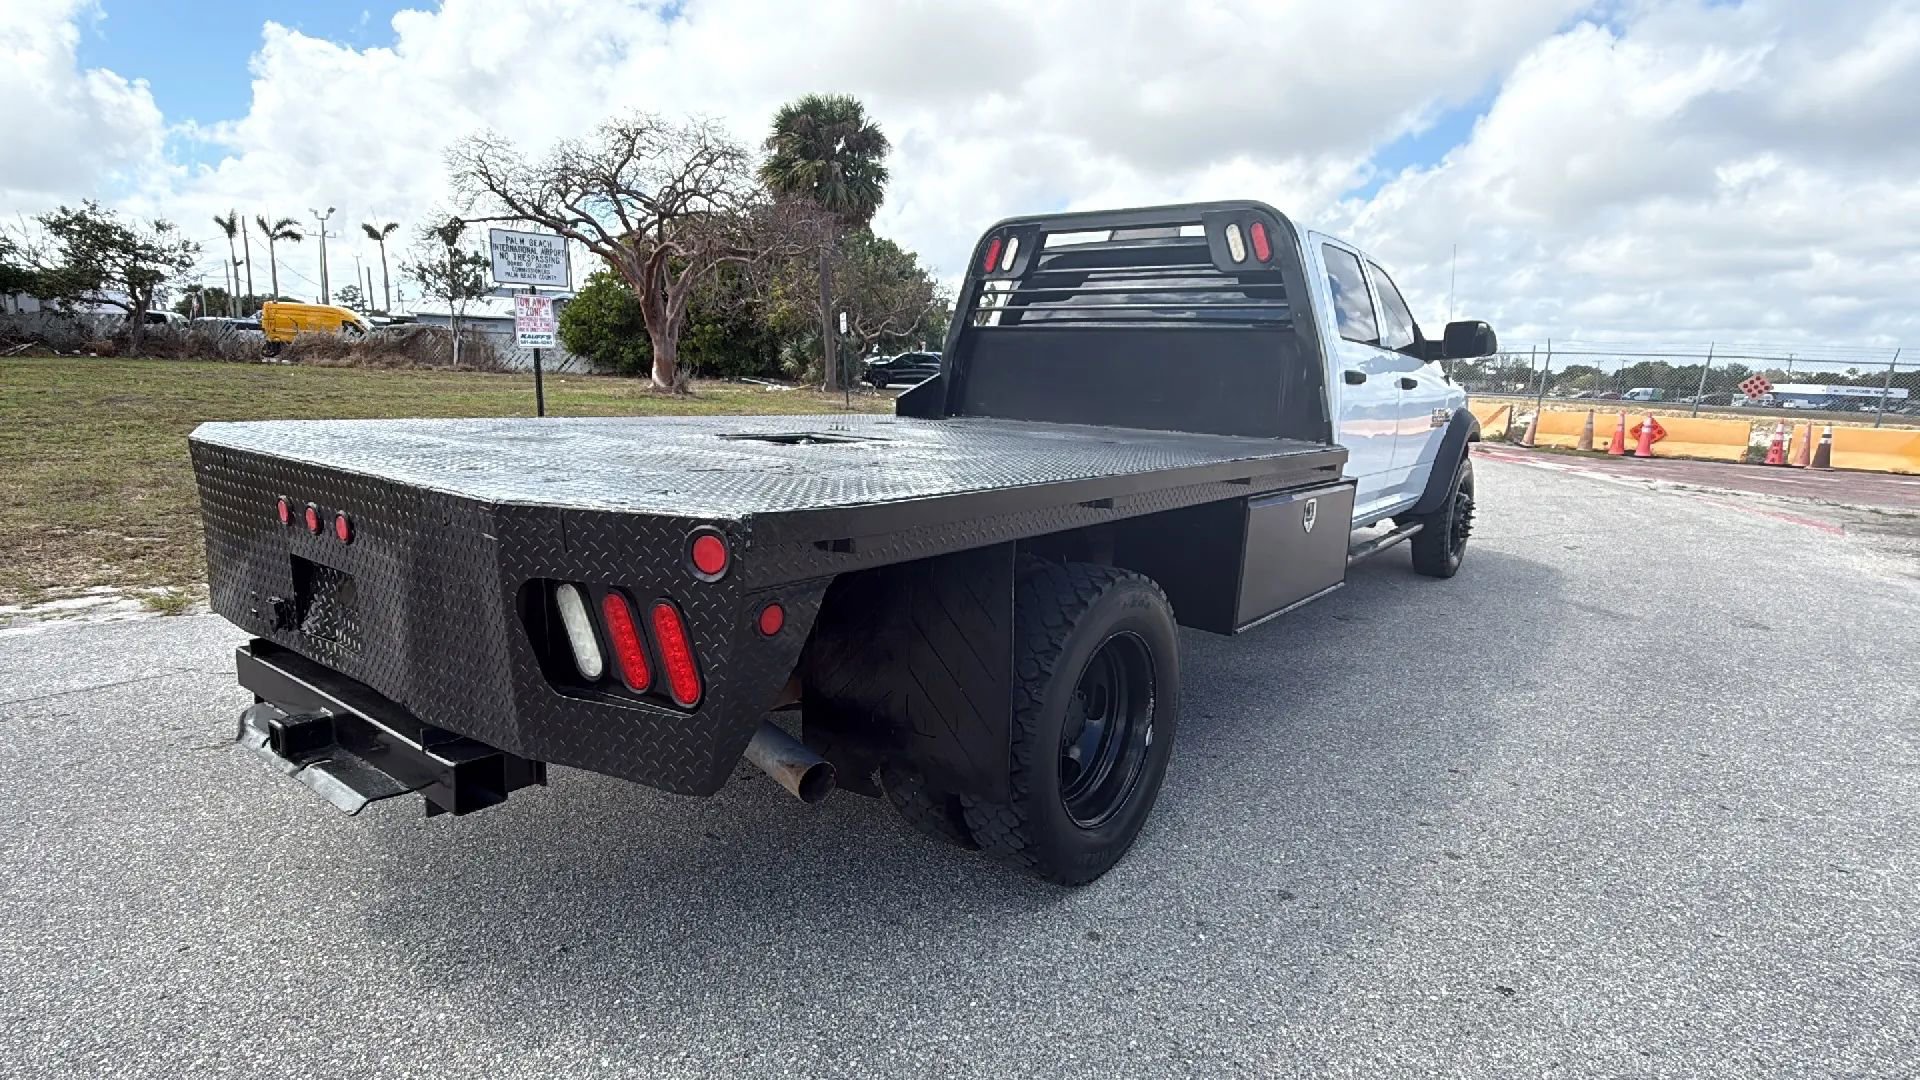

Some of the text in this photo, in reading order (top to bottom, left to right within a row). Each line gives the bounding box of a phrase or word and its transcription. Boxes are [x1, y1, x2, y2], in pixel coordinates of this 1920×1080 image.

[505, 236, 552, 248] PALM BEACH
[493, 244, 565, 257] INTERNATIONAL AIRPORT
[499, 252, 560, 264] NO TRESPASSING
[516, 297, 550, 308] TOW AWAY
[526, 307, 543, 317] ZONE
